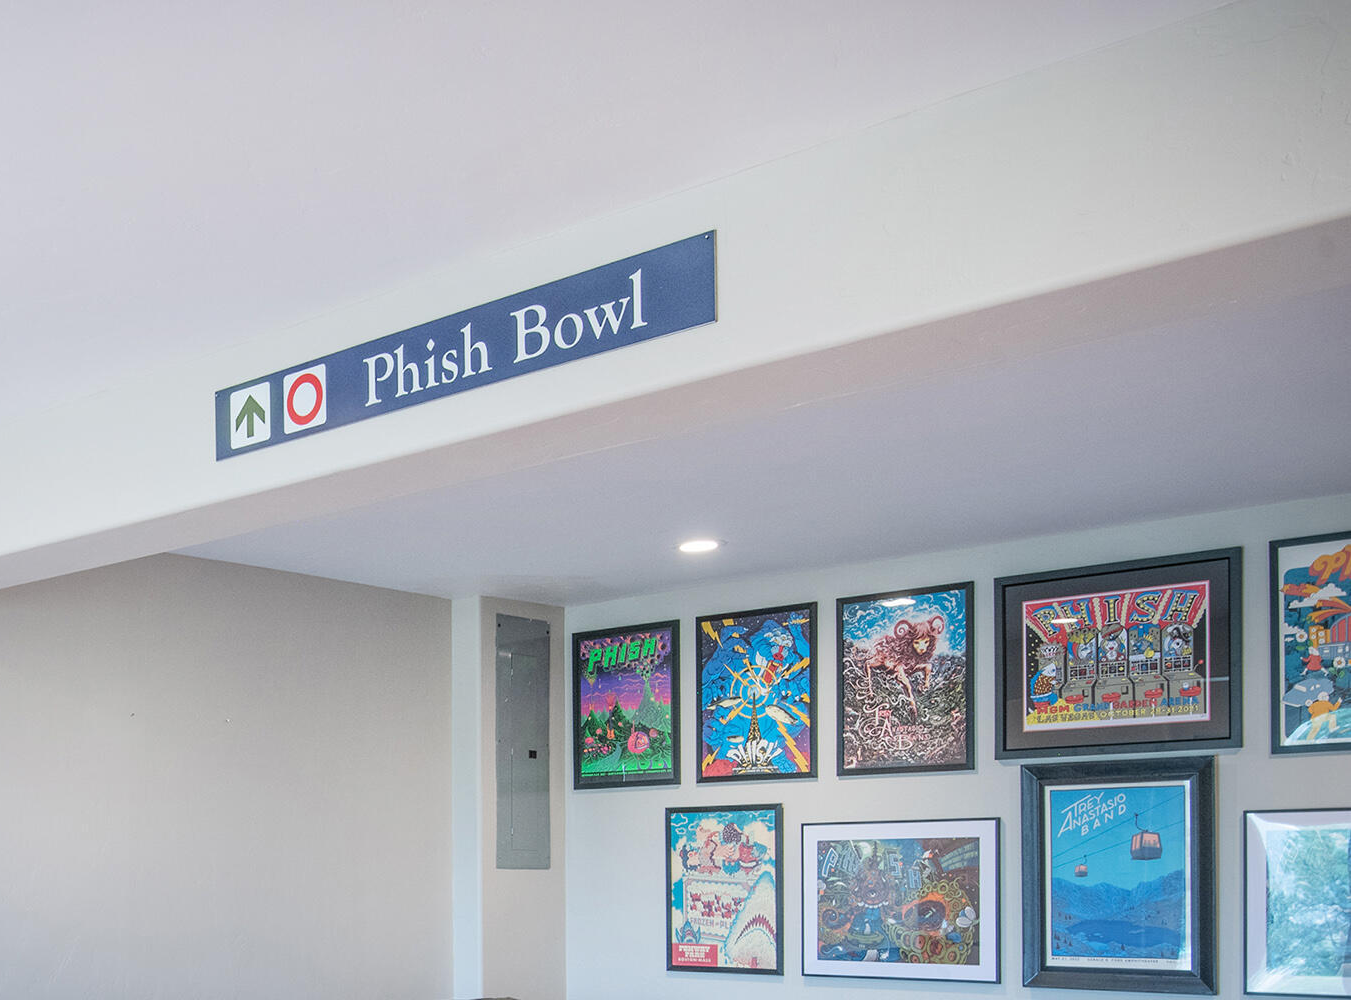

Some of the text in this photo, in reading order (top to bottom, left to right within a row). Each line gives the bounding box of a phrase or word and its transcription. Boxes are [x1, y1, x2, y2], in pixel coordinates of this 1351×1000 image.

[363, 268, 648, 407] Phish Bowl
[1032, 589, 1199, 637] PHISH
[587, 638, 658, 674] PHISH
[1073, 702, 1110, 713] GRAND
[1112, 698, 1157, 709] GARDEN
[1160, 697, 1199, 707] ARENA
[1099, 708, 1146, 719] OCTOBER
[726, 738, 783, 764] PHISH
[1057, 793, 1127, 838] ANASTASIO
[1060, 791, 1105, 817] TREY
[1081, 804, 1127, 836] BAND
